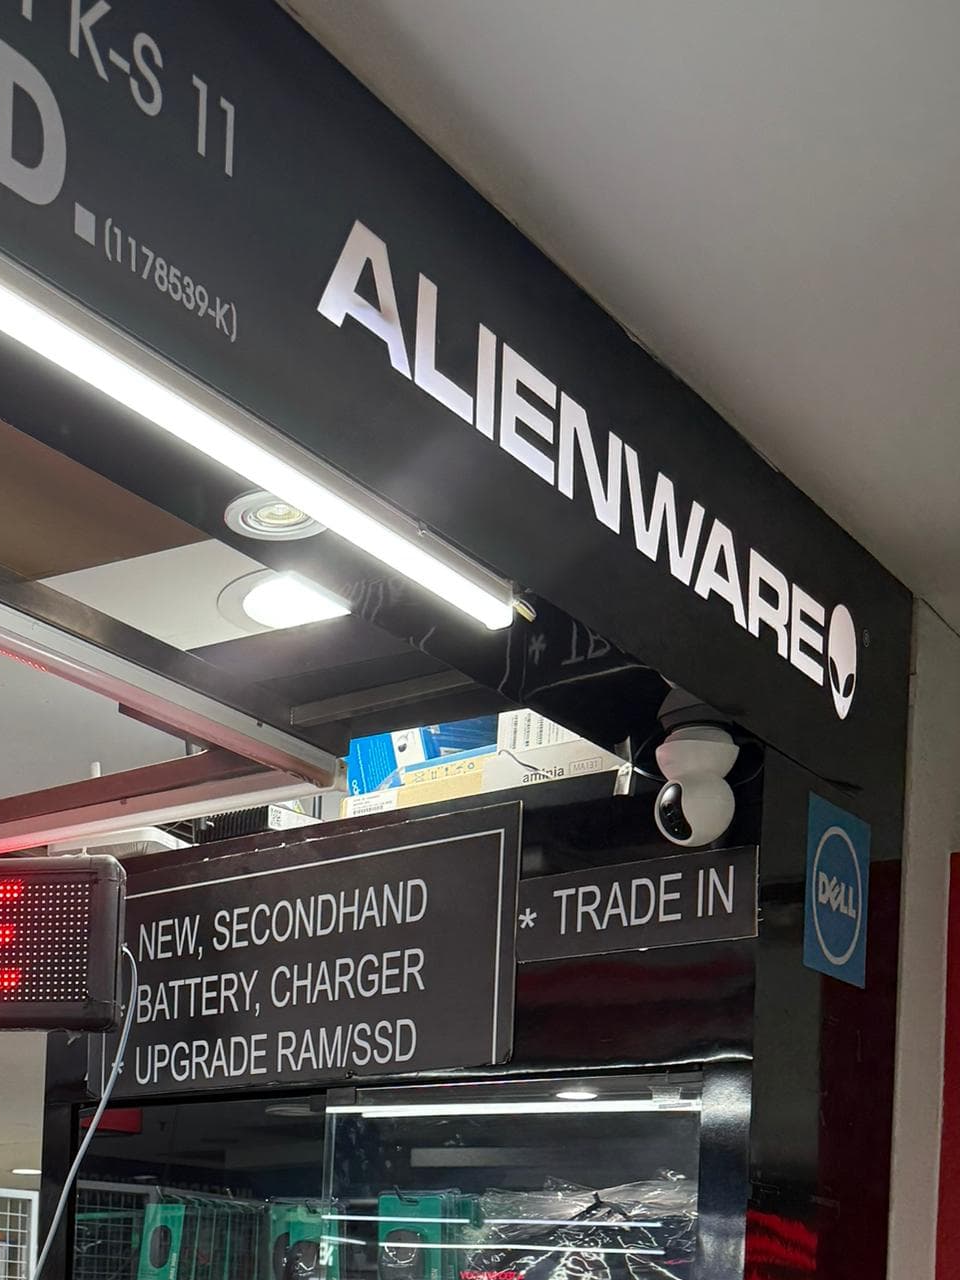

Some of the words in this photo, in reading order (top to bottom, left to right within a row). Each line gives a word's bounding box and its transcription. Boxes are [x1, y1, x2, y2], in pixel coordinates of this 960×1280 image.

[192, 74, 235, 177] 11
[104, 217, 238, 342] (1178539-K)
[317, 219, 825, 686] ALIENWARE
[138, 914, 204, 961] NEW,
[212, 878, 428, 952] SECONDHAND
[553, 872, 683, 935] TRADE
[697, 865, 736, 918] IN
[818, 871, 856, 919] DELL
[136, 970, 261, 1023] BATTERY,
[270, 948, 426, 1008] CHARGER
[135, 1033, 268, 1085] UPGRADE
[277, 1019, 417, 1072] RAM/SSD
